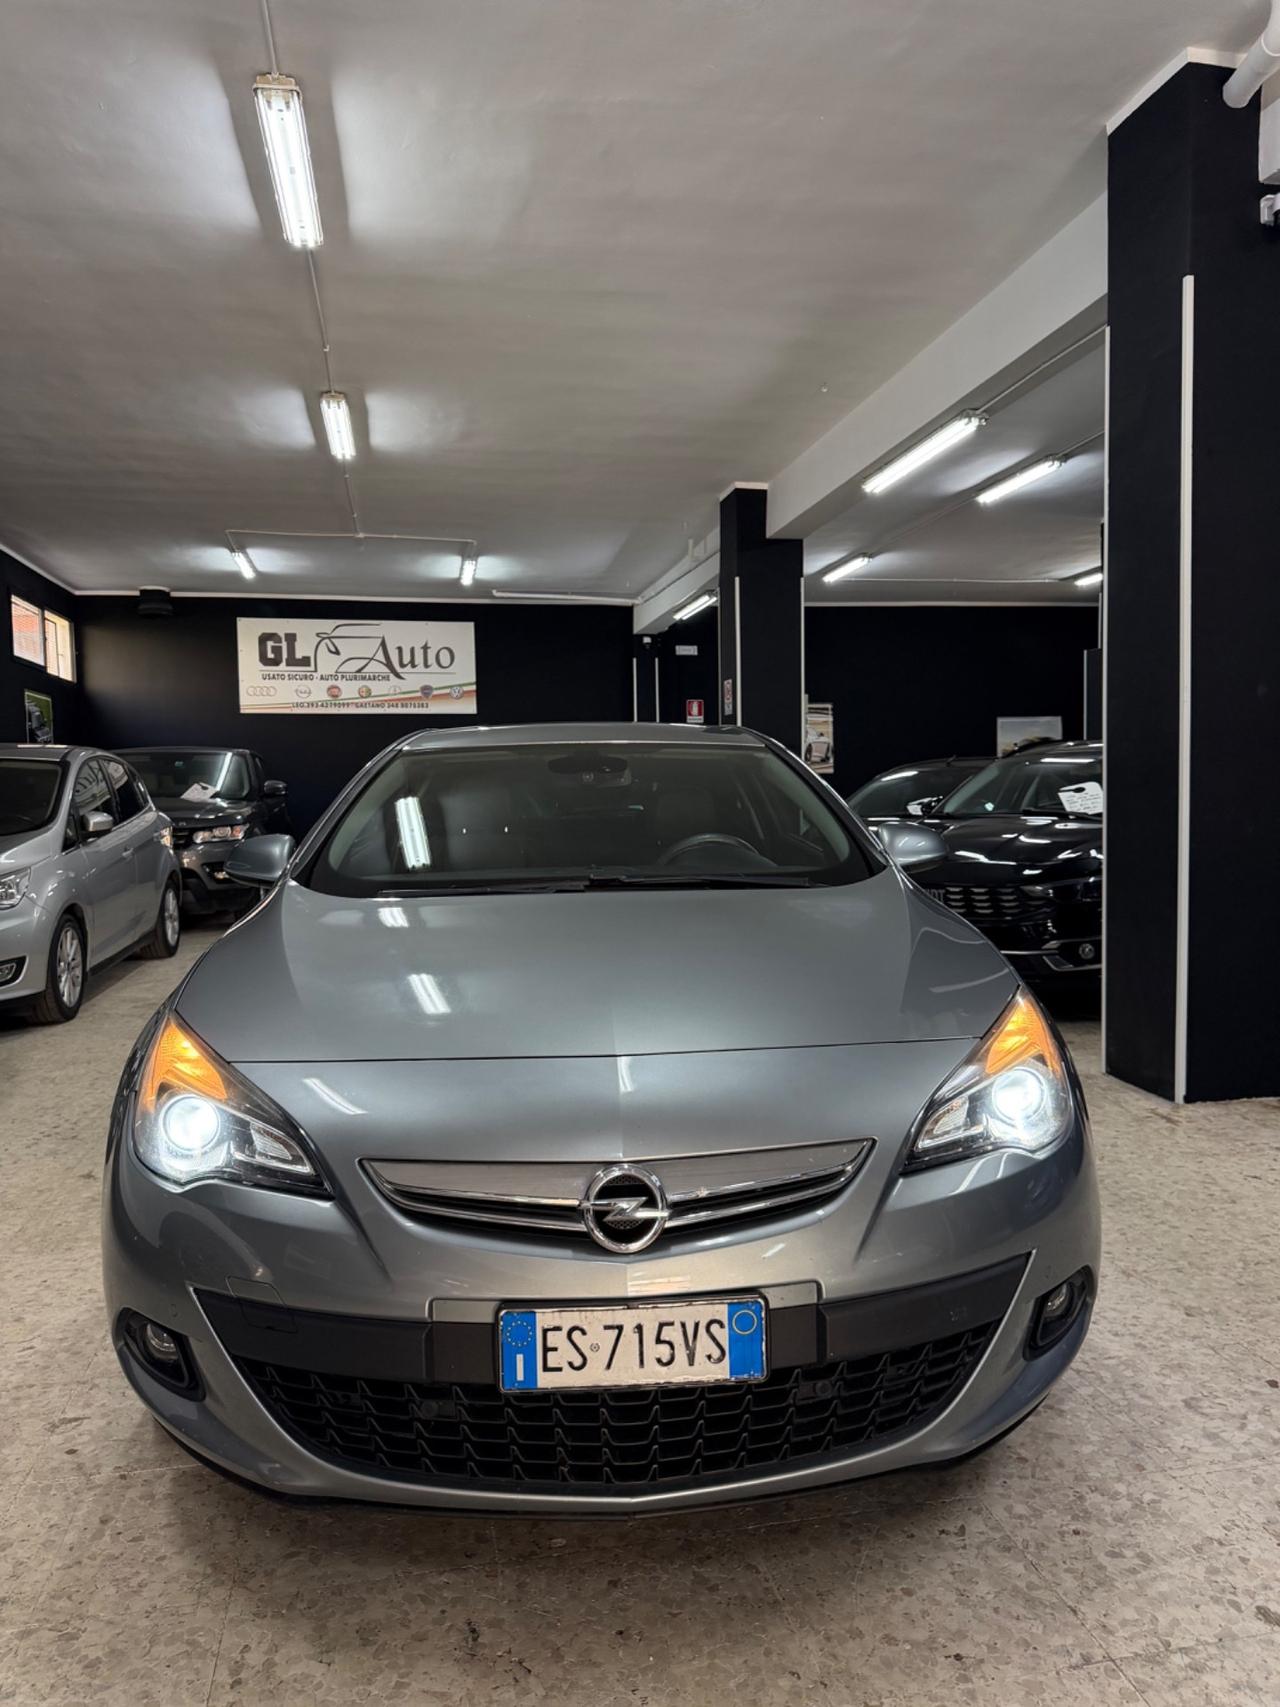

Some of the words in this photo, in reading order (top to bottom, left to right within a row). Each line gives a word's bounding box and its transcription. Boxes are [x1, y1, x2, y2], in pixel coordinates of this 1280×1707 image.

[258, 632, 311, 667] GL
[356, 635, 456, 680] Auto
[262, 673, 286, 681] USATO
[287, 673, 314, 682] SICURO
[319, 674, 339, 682] AUTO
[340, 673, 391, 682] PLURIMARCHE
[541, 1324, 588, 1373] ES
[602, 1318, 727, 1371] 715VS
